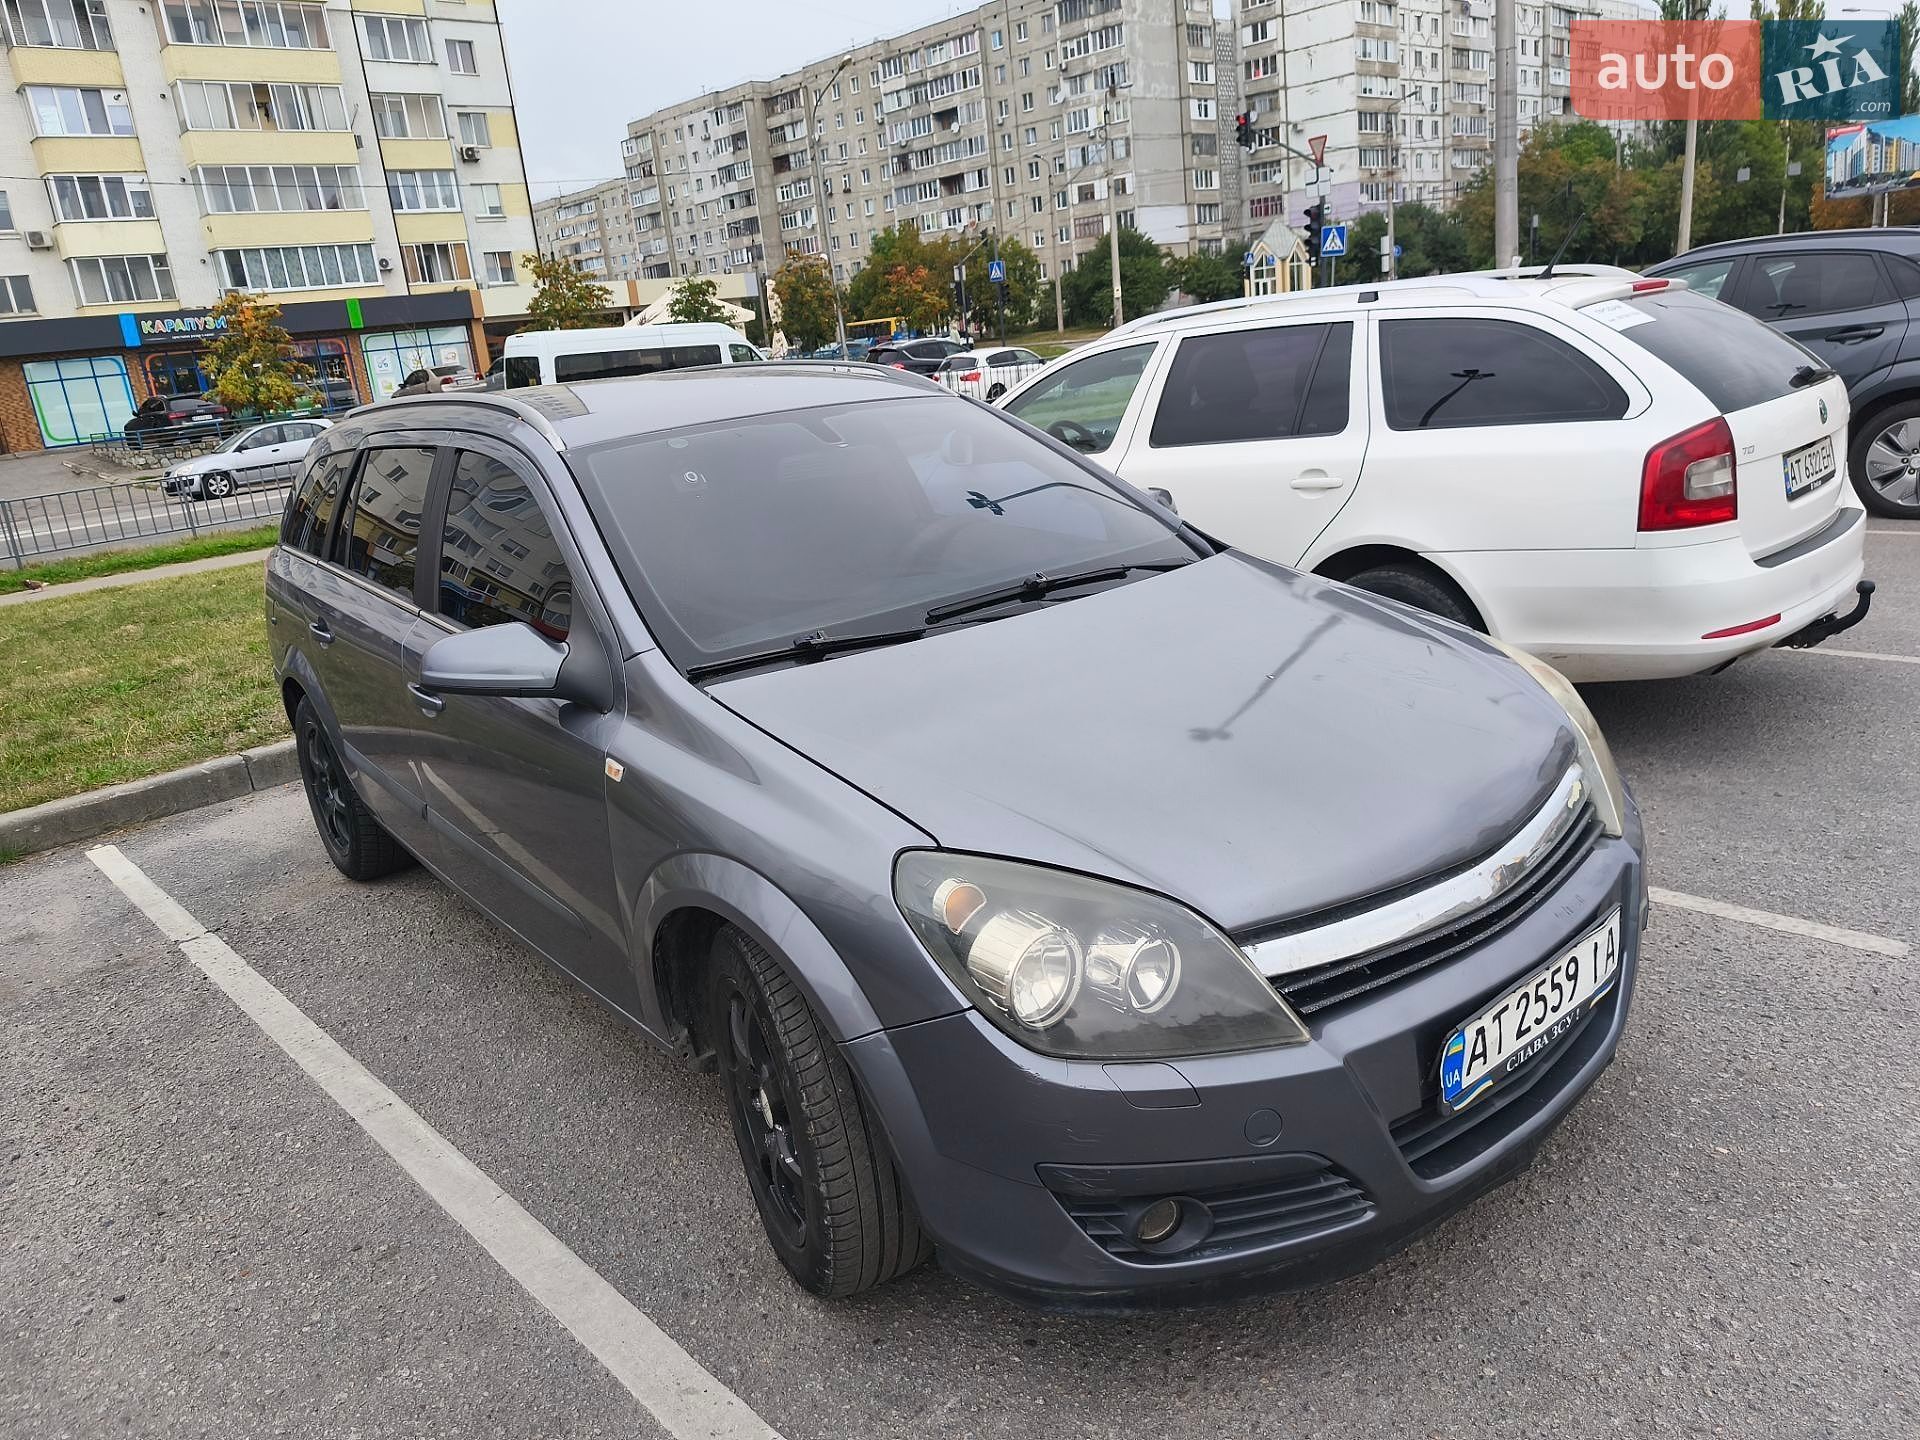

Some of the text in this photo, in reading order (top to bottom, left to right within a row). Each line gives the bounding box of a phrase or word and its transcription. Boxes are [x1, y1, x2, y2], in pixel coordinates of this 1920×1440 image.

[141, 314, 231, 334] КАРАПУЗИ
[1790, 458, 1802, 488] AT
[1804, 449, 1823, 480] 6322
[1466, 926, 1616, 1078] AT 2559 IA
[1506, 1034, 1550, 1072] СЛАВА
[1445, 1071, 1461, 1088] UA
